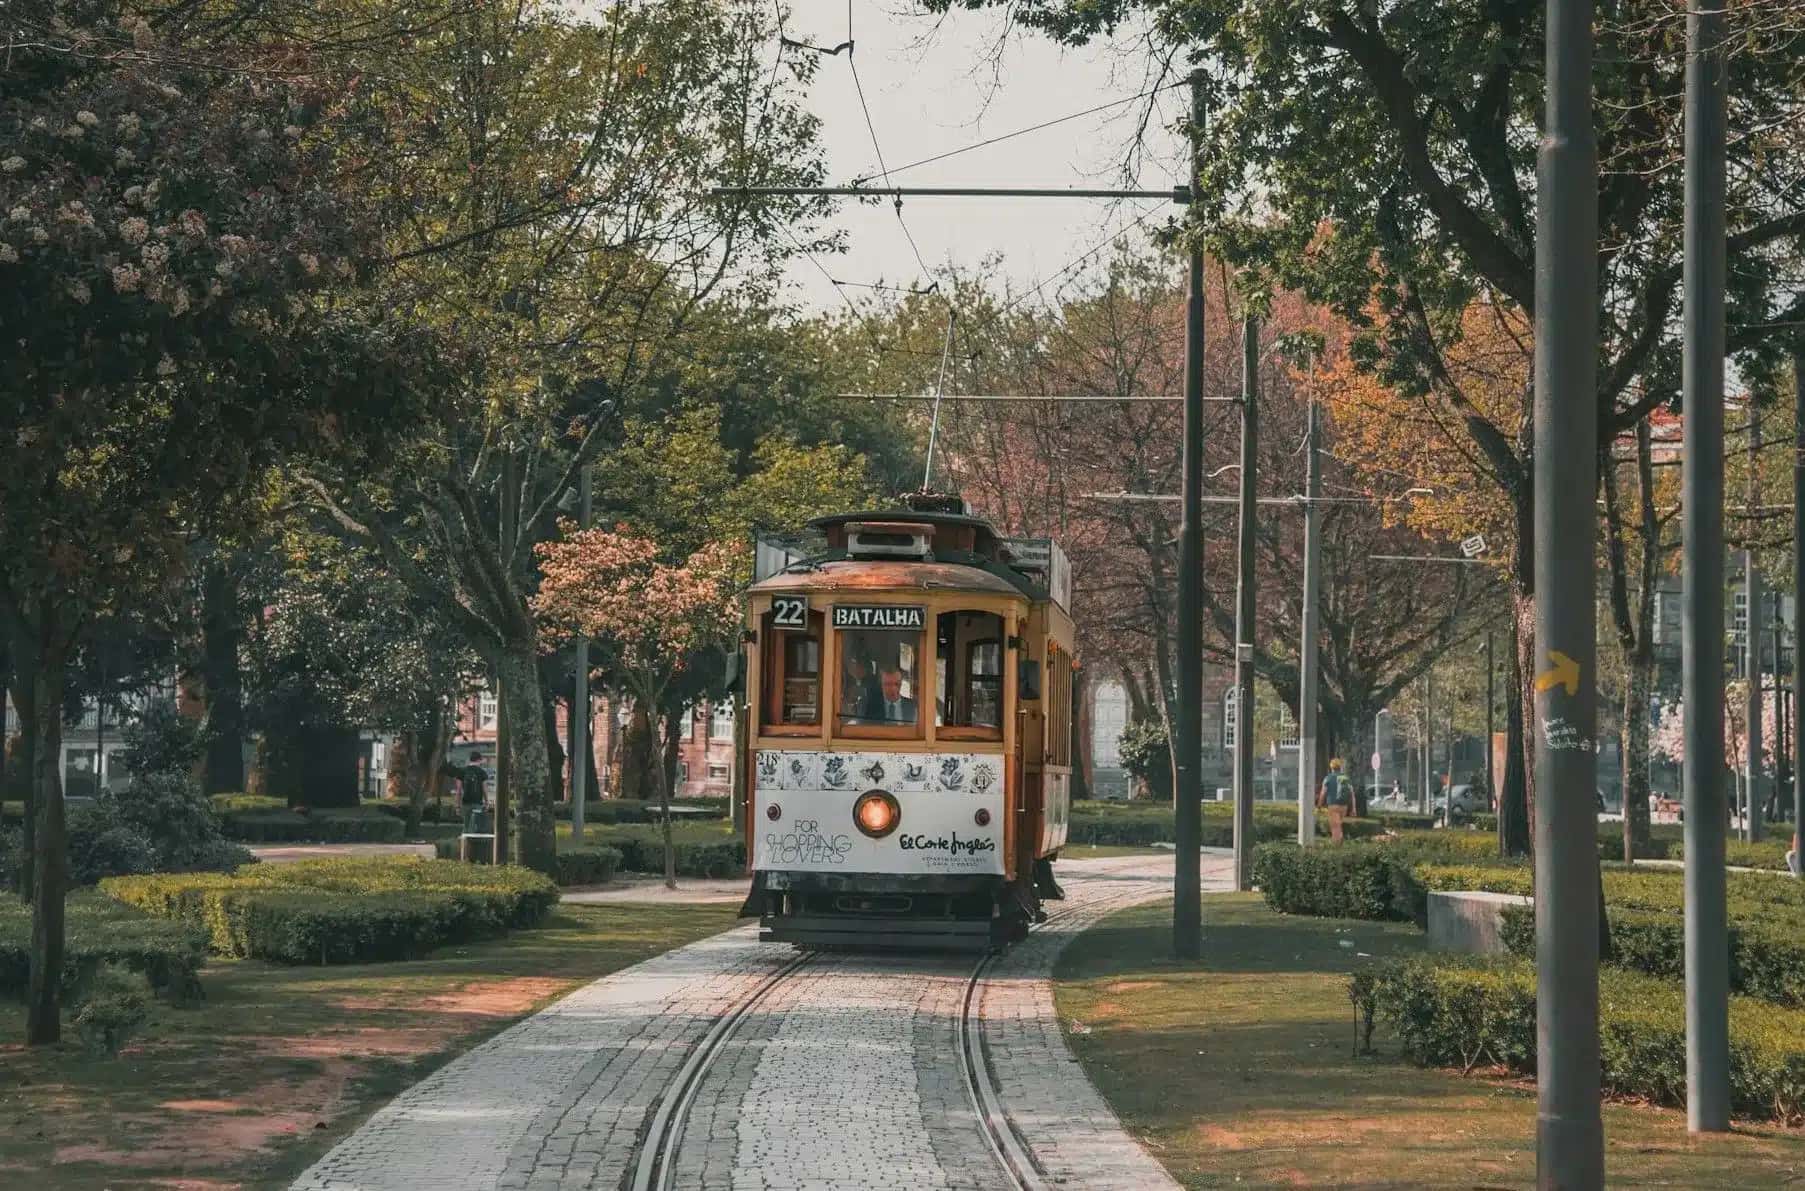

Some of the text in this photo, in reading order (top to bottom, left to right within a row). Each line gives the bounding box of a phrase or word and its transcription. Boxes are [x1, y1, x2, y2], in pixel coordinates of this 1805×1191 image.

[774, 600, 803, 624] 22
[836, 608, 921, 626] BATALHA
[794, 820, 818, 832] FOR
[766, 834, 852, 854] SHOPPING
[900, 834, 914, 849] El
[915, 835, 948, 849] Corte
[771, 846, 844, 863] LOVERS
